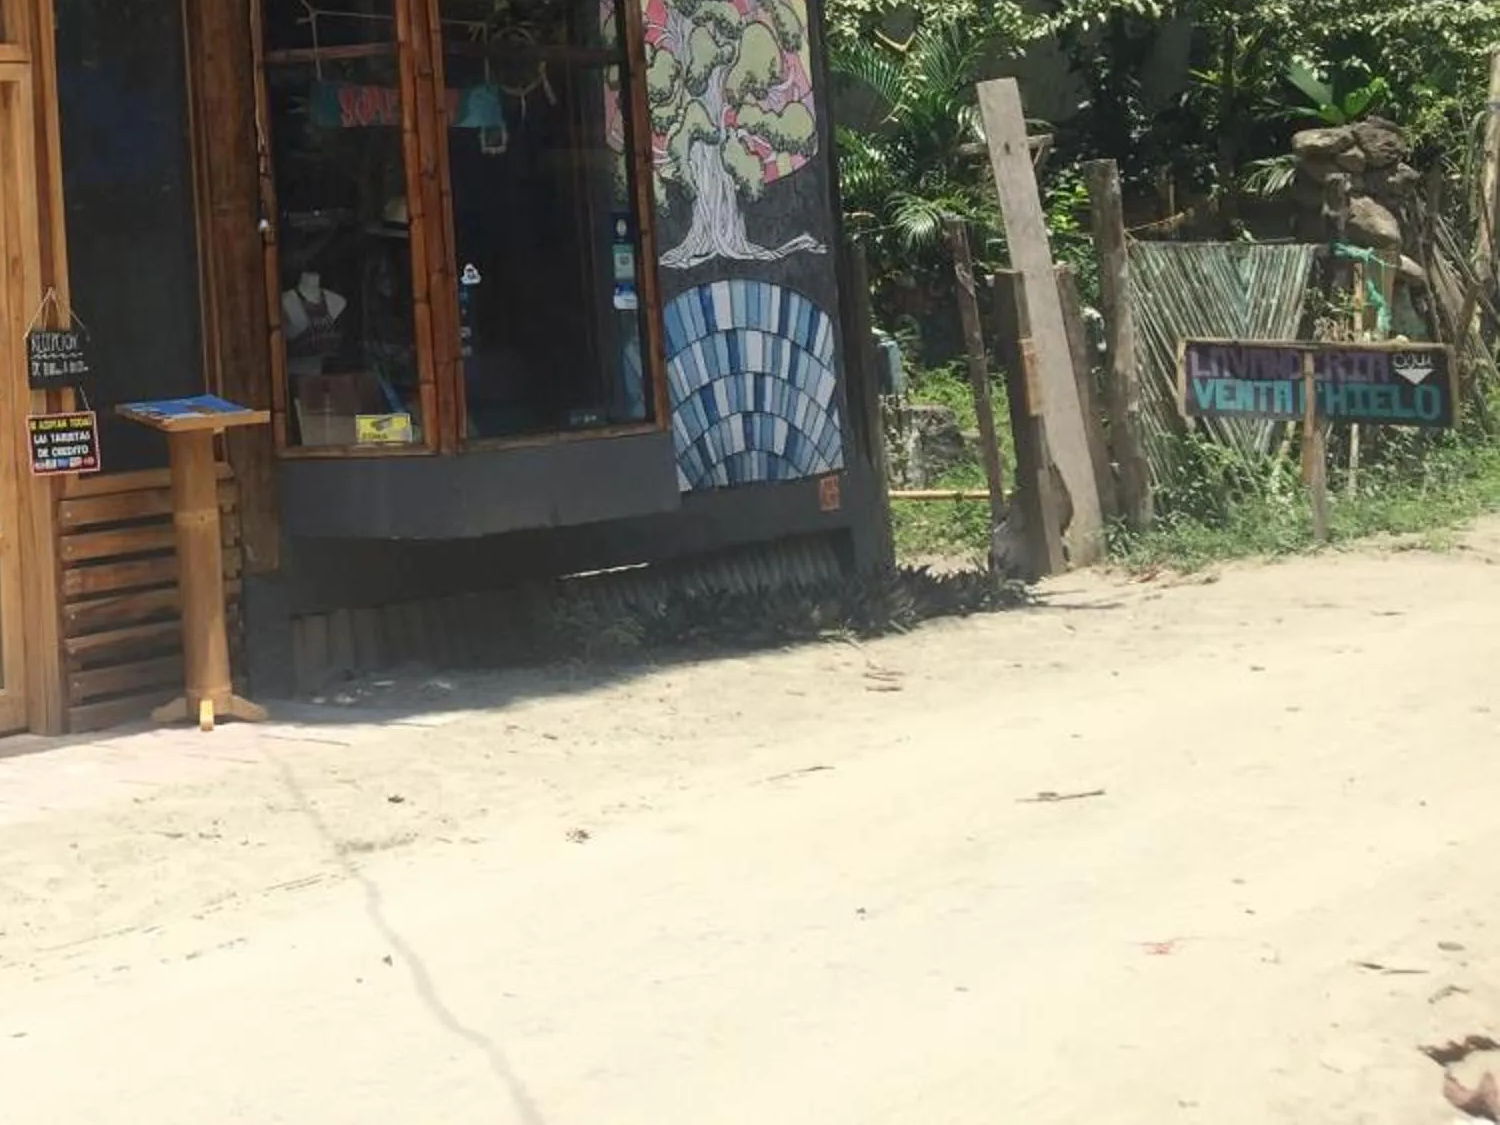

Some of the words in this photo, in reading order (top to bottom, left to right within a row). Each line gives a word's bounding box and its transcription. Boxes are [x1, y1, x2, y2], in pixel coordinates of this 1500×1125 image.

[1190, 349, 1390, 383] LAVANDRIA
[1191, 377, 1294, 413] VENTA
[33, 432, 48, 444] LAS
[51, 430, 91, 443] TARJETAS
[37, 447, 49, 458] DE
